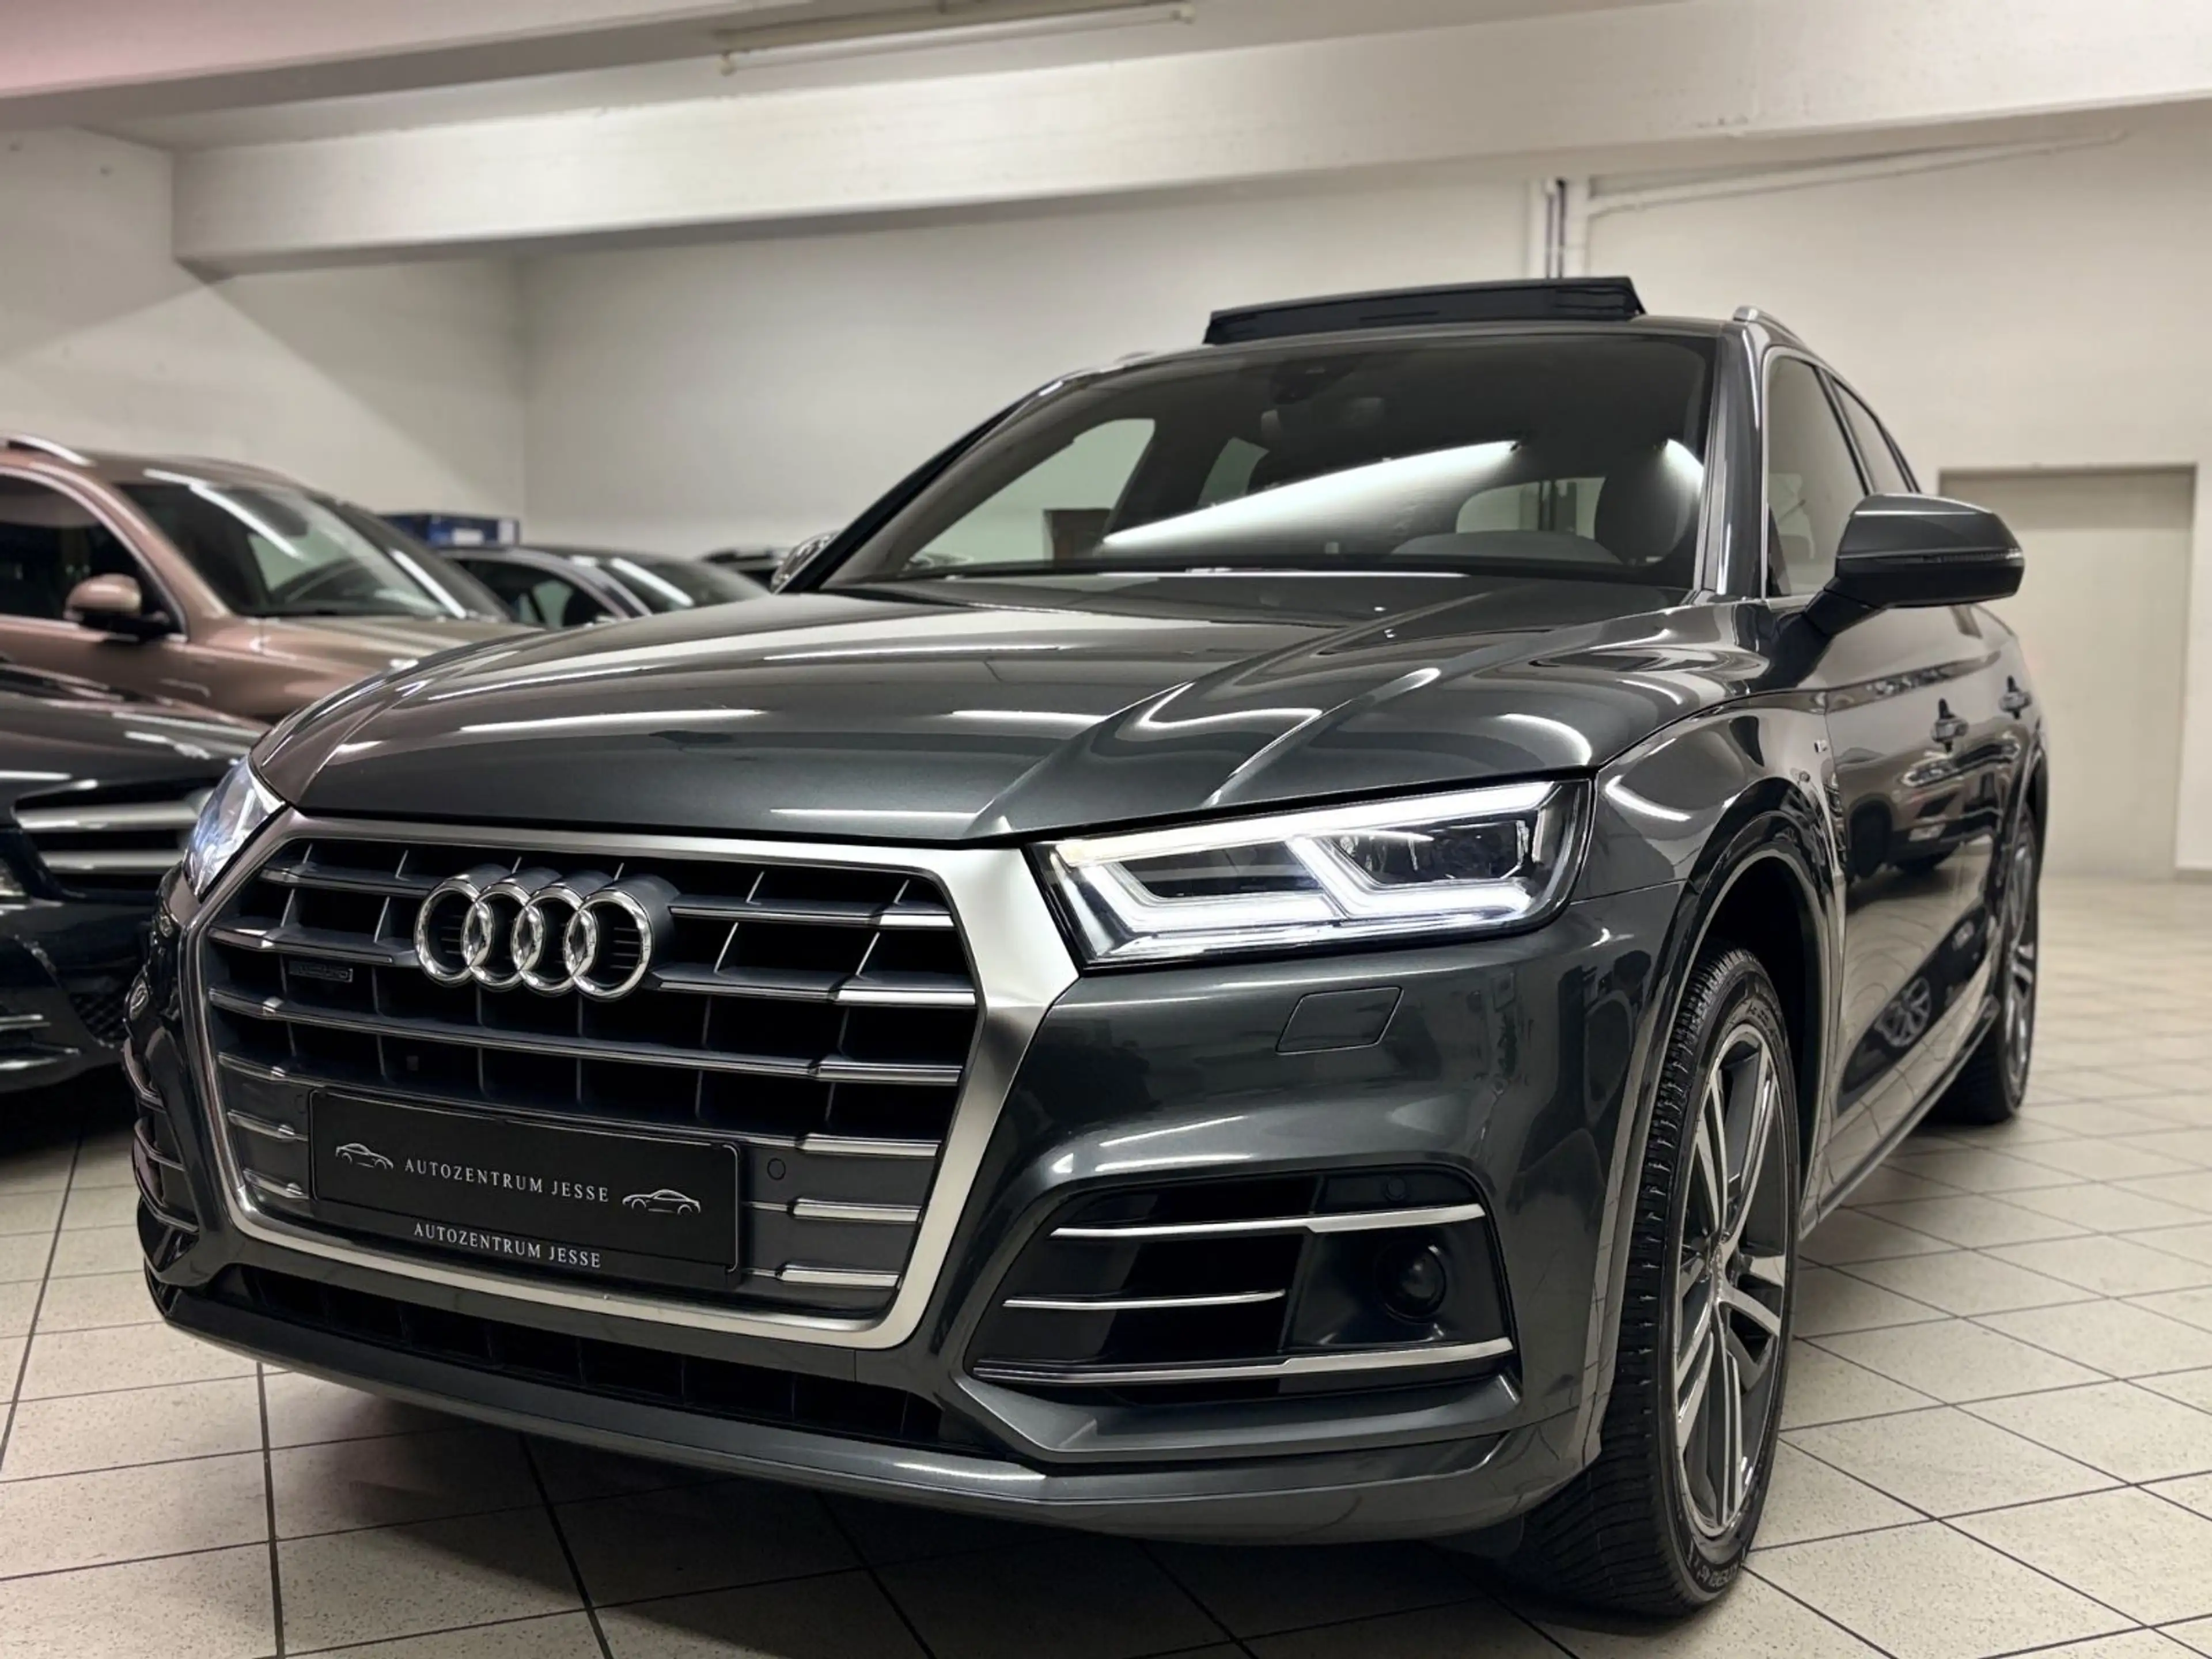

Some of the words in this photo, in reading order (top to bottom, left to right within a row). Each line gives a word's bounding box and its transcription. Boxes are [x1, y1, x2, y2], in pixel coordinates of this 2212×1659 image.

[405, 1158, 543, 1193] AUTOZENTRUM
[551, 1181, 608, 1202] JESSE
[414, 1222, 541, 1259] AUTOZENTRUM
[548, 1246, 601, 1268] JESSE
